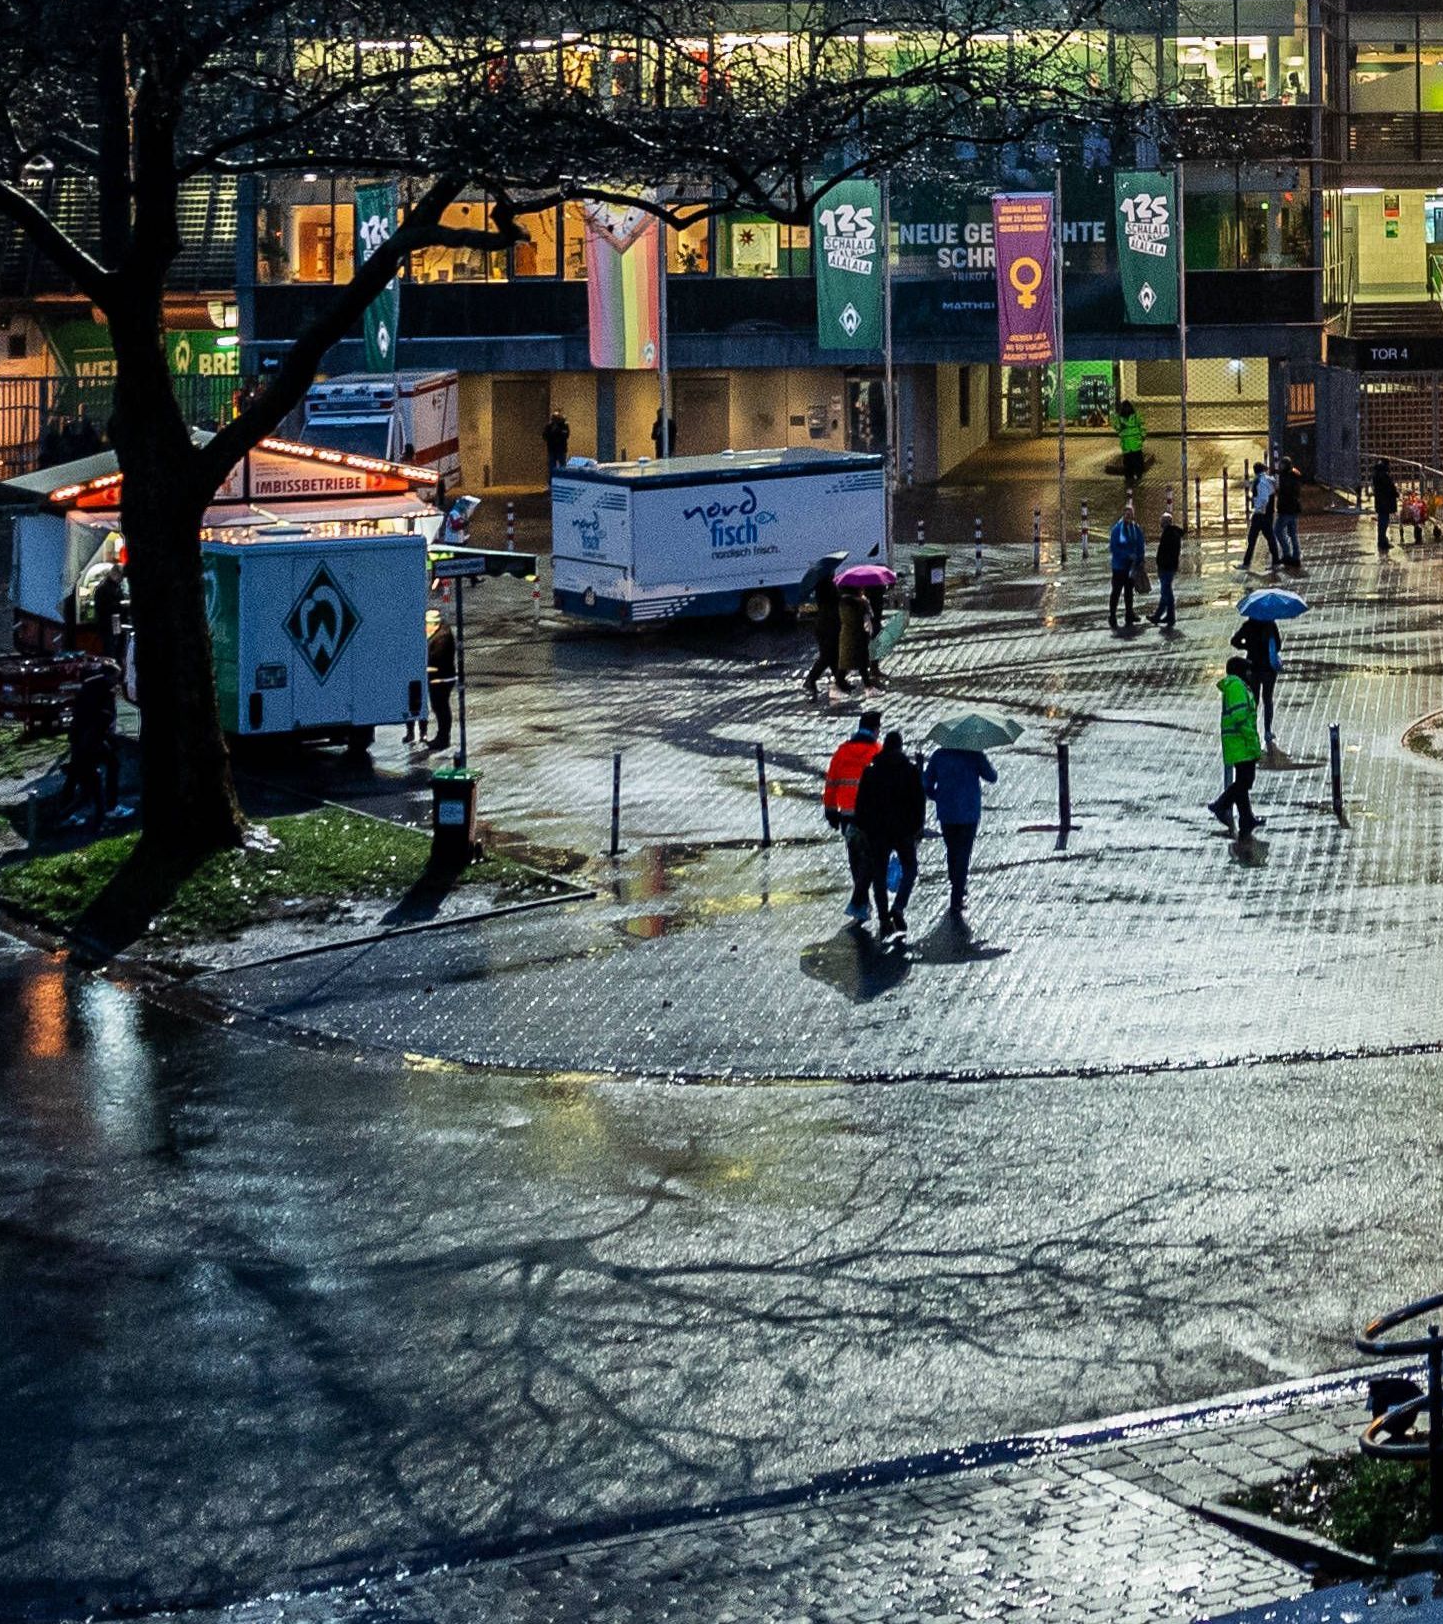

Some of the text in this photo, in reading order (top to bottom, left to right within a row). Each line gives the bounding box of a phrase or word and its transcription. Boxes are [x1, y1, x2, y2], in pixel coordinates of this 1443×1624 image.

[1120, 194, 1169, 224] 125
[819, 204, 875, 239] 125
[1126, 223, 1169, 236] SCHALALA
[900, 223, 958, 244] NEUE
[825, 237, 875, 251] SCHALALA
[829, 254, 870, 273] ALALALA
[1371, 348, 1408, 360] TOR 4
[255, 476, 362, 494] IMBISSBETRIEBE
[683, 485, 757, 527] nord
[710, 515, 758, 547] fisch
